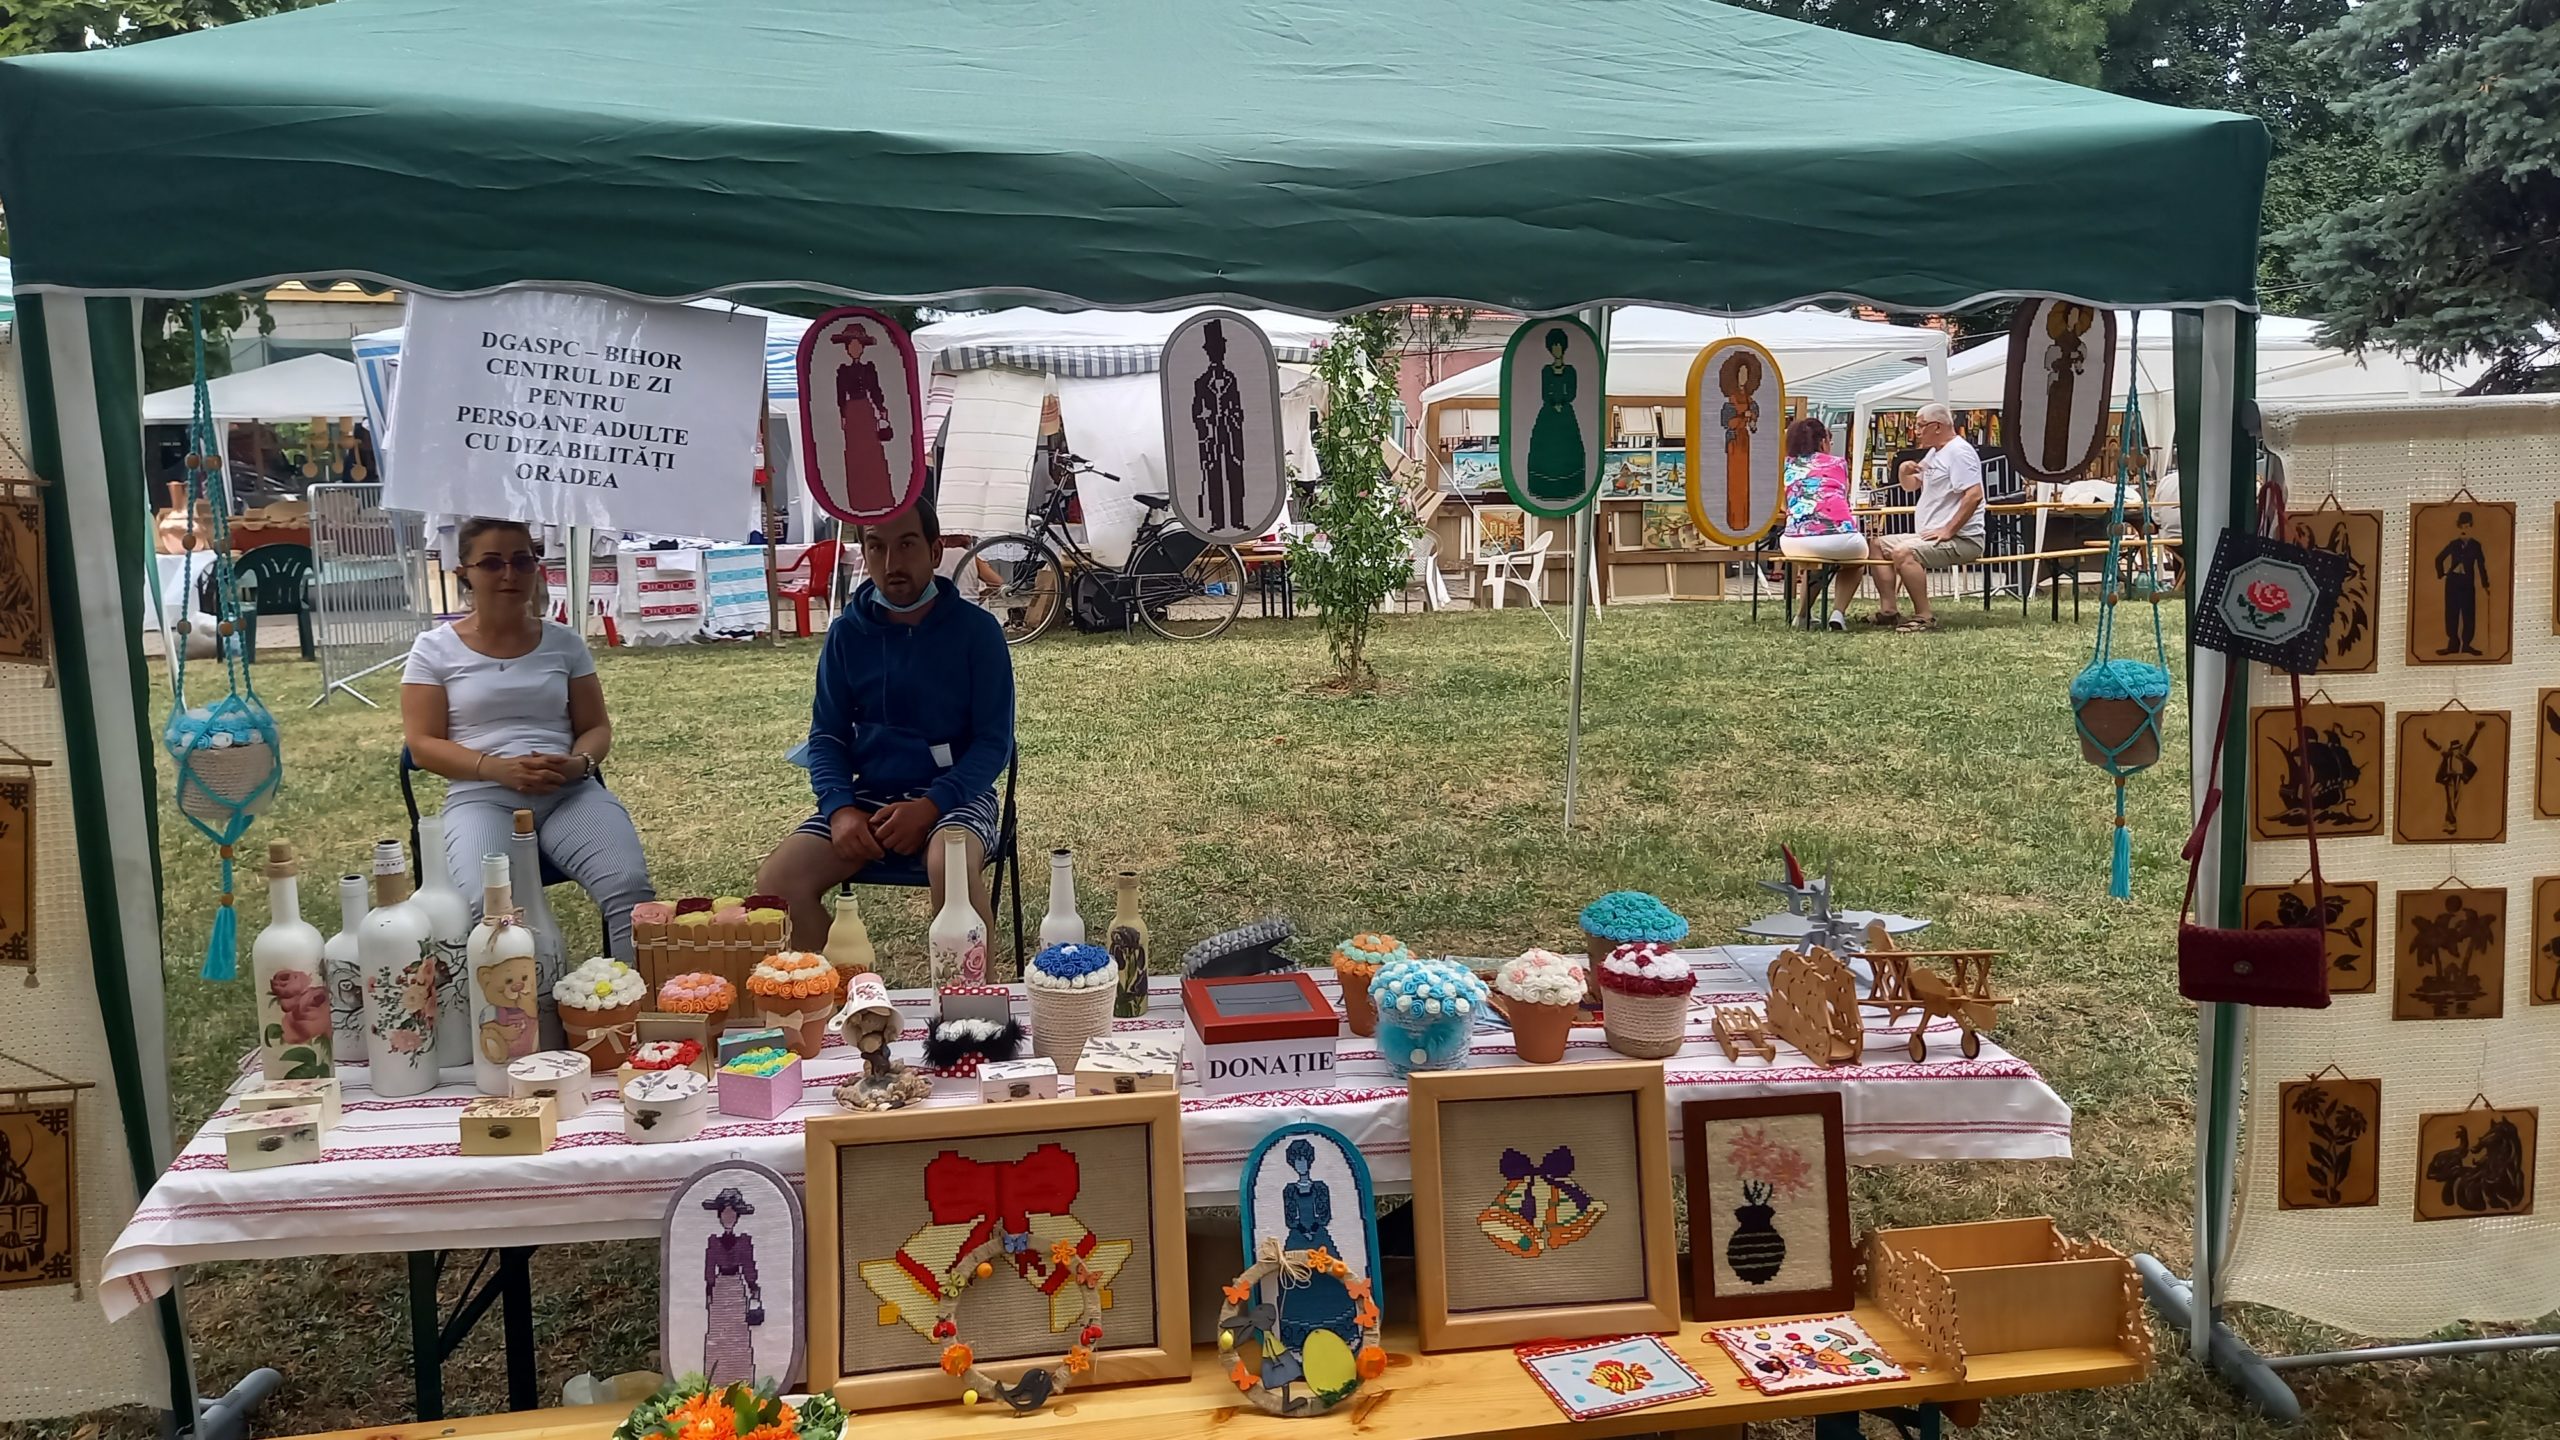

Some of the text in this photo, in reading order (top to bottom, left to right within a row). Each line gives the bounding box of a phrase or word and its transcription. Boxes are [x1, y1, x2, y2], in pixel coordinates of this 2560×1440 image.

[481, 331, 580, 358] DGASPC
[604, 345, 683, 370] BIHOR
[486, 357, 672, 394] CENTRUL DE ZI
[528, 387, 627, 413] PENTRU
[456, 405, 690, 446] PERSOANE ADULTE
[464, 431, 676, 472] CU DIZABILITĂȚI
[515, 463, 620, 488] ORADEA
[1208, 1051, 1334, 1080] DONAȚIE
